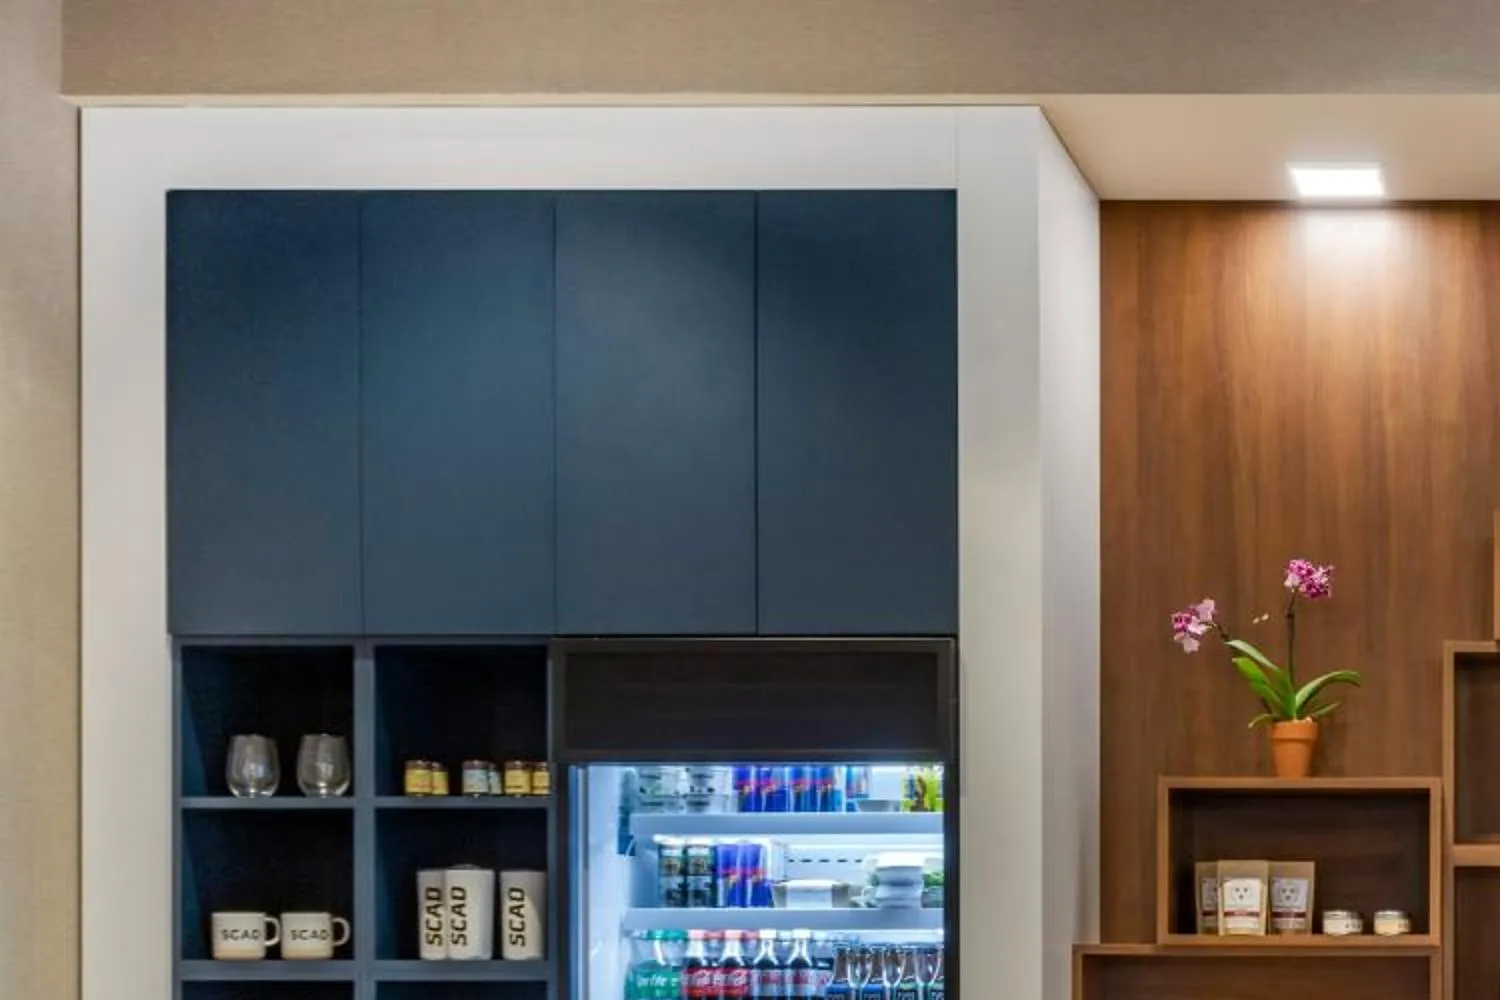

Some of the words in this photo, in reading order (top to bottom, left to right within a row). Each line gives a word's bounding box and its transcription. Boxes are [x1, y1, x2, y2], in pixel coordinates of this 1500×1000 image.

[222, 928, 261, 941] SCAD
[290, 928, 330, 941] SCAD
[425, 886, 443, 946] SCAD
[450, 886, 468, 946] SCAD
[507, 886, 526, 947] SCAD
